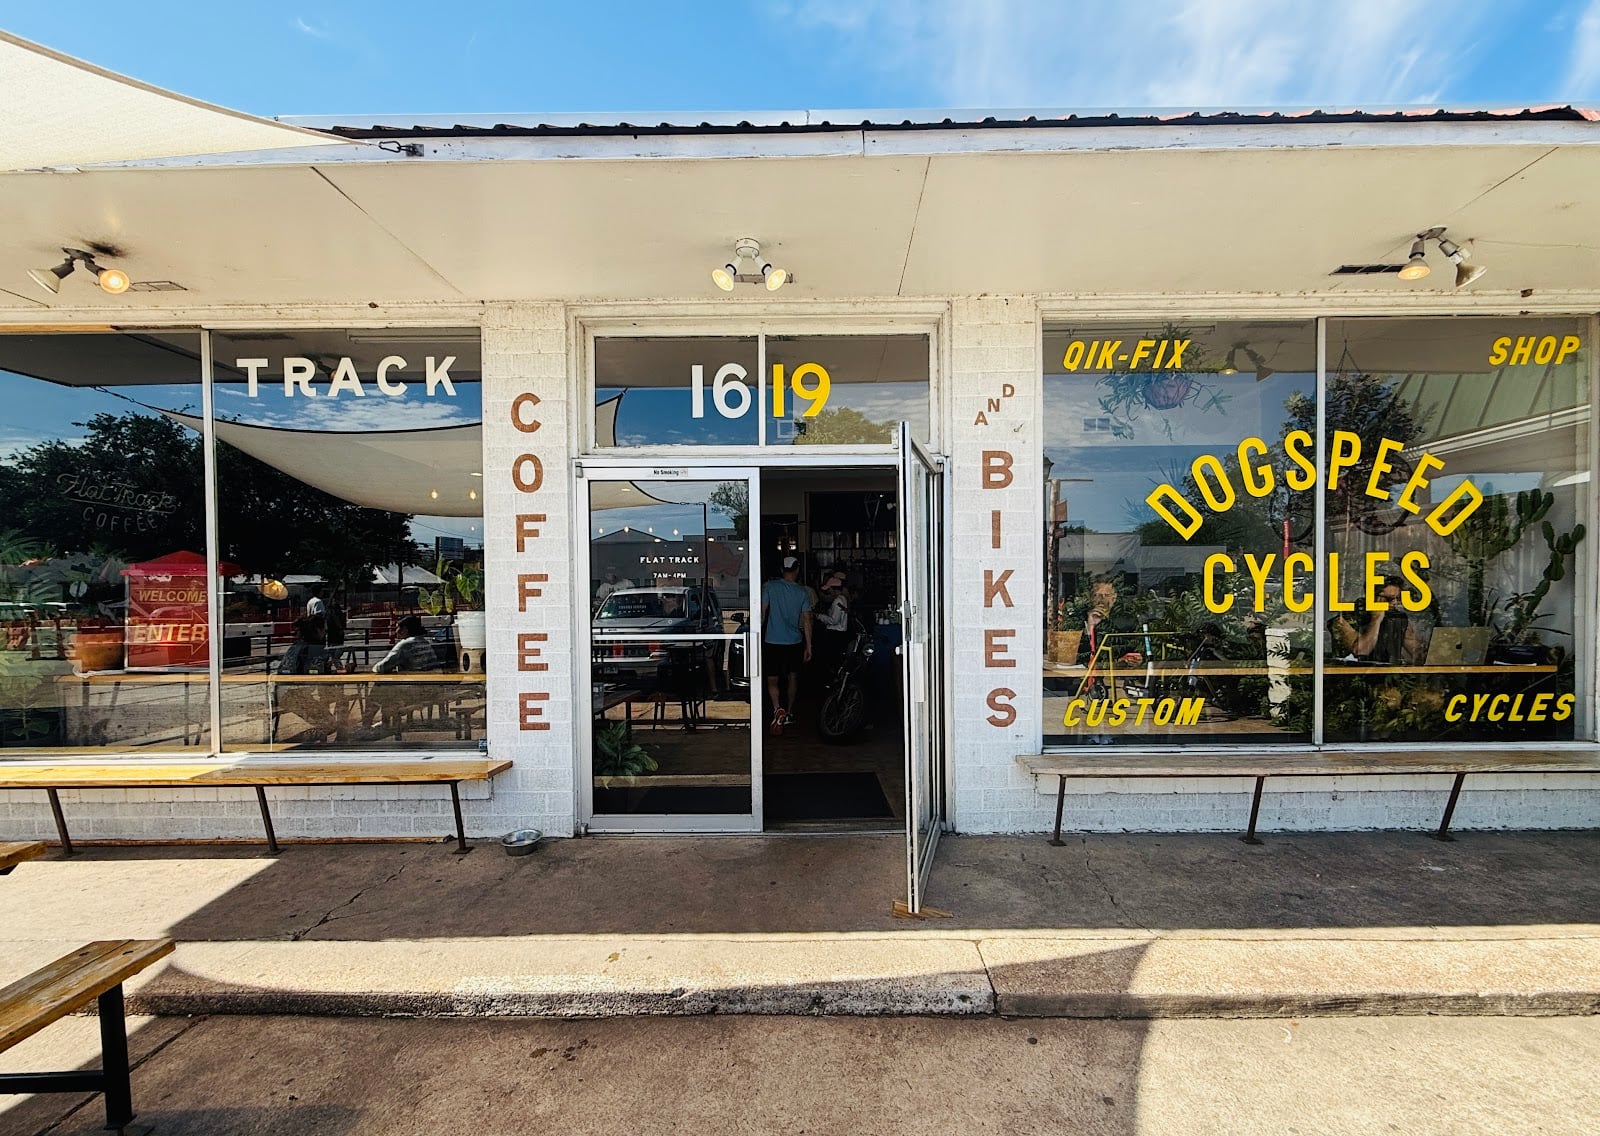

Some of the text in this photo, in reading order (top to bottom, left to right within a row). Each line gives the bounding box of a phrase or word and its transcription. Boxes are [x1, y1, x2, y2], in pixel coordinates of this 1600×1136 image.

[1062, 339, 1189, 371] QIK-FIX
[1488, 335, 1581, 366] SHOP
[236, 355, 457, 400] TRACK
[974, 383, 1016, 426] AND
[57, 473, 111, 501] Flat
[1145, 430, 1484, 540] DOGSPEED
[82, 506, 158, 533] COFFEE
[510, 392, 551, 731] COFFEE
[640, 556, 700, 564] FLAT TRACK
[140, 590, 207, 602] WELCOME
[982, 450, 1017, 728] BIKES
[1203, 550, 1433, 614] CYCLES
[133, 622, 207, 641] ENTER
[1062, 696, 1206, 728] CUSTOM
[1445, 692, 1576, 722] CYCLES
